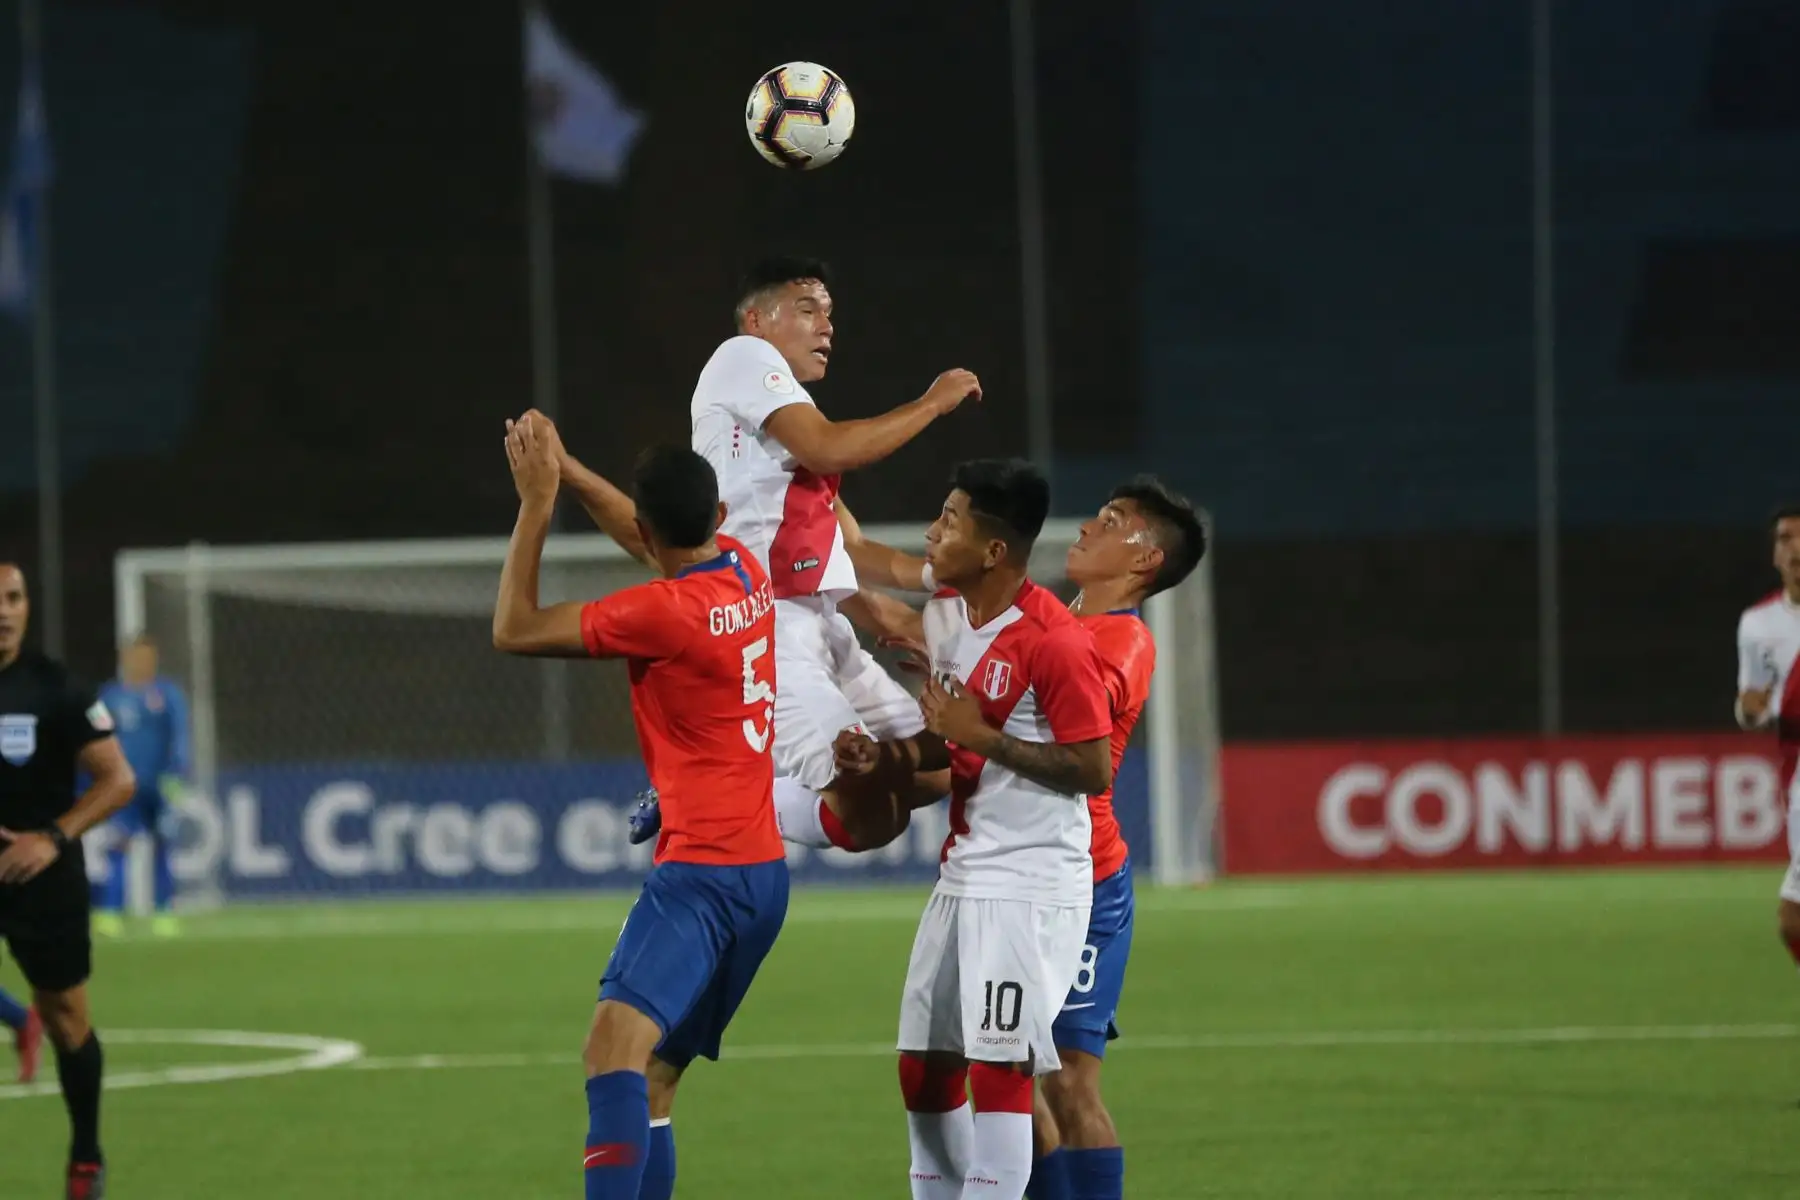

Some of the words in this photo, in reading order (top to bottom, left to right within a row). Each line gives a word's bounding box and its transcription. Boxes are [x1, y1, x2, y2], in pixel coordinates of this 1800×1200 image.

[742, 635, 775, 753] 5
[302, 780, 542, 878] Cree
[1073, 944, 1098, 993] 8
[980, 979, 1024, 1032] 10
[975, 1035, 1021, 1046] marathon
